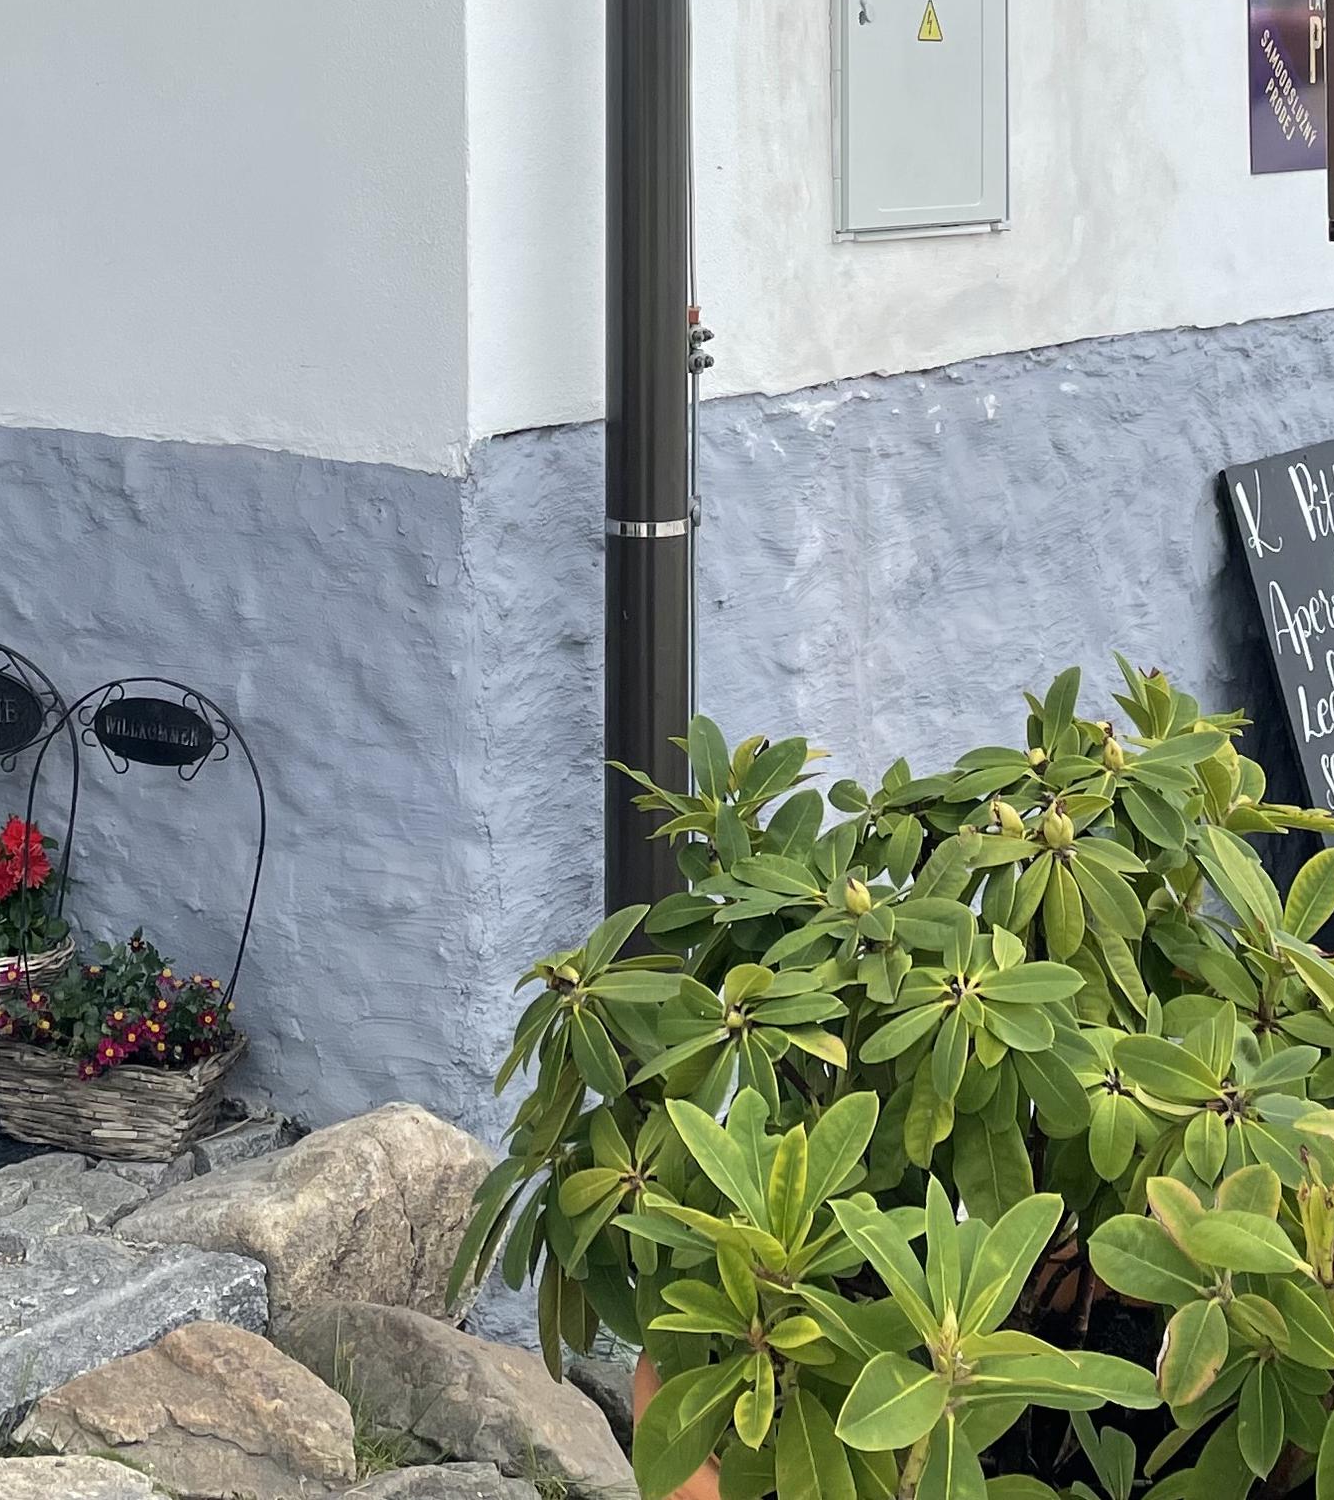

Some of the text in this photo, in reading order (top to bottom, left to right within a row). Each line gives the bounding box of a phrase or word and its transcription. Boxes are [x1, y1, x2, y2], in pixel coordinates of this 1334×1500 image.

[1259, 29, 1318, 149] SAMOOBSLUŽNÝ
[1264, 77, 1296, 141] PRODEJ
[1234, 467, 1283, 559] K
